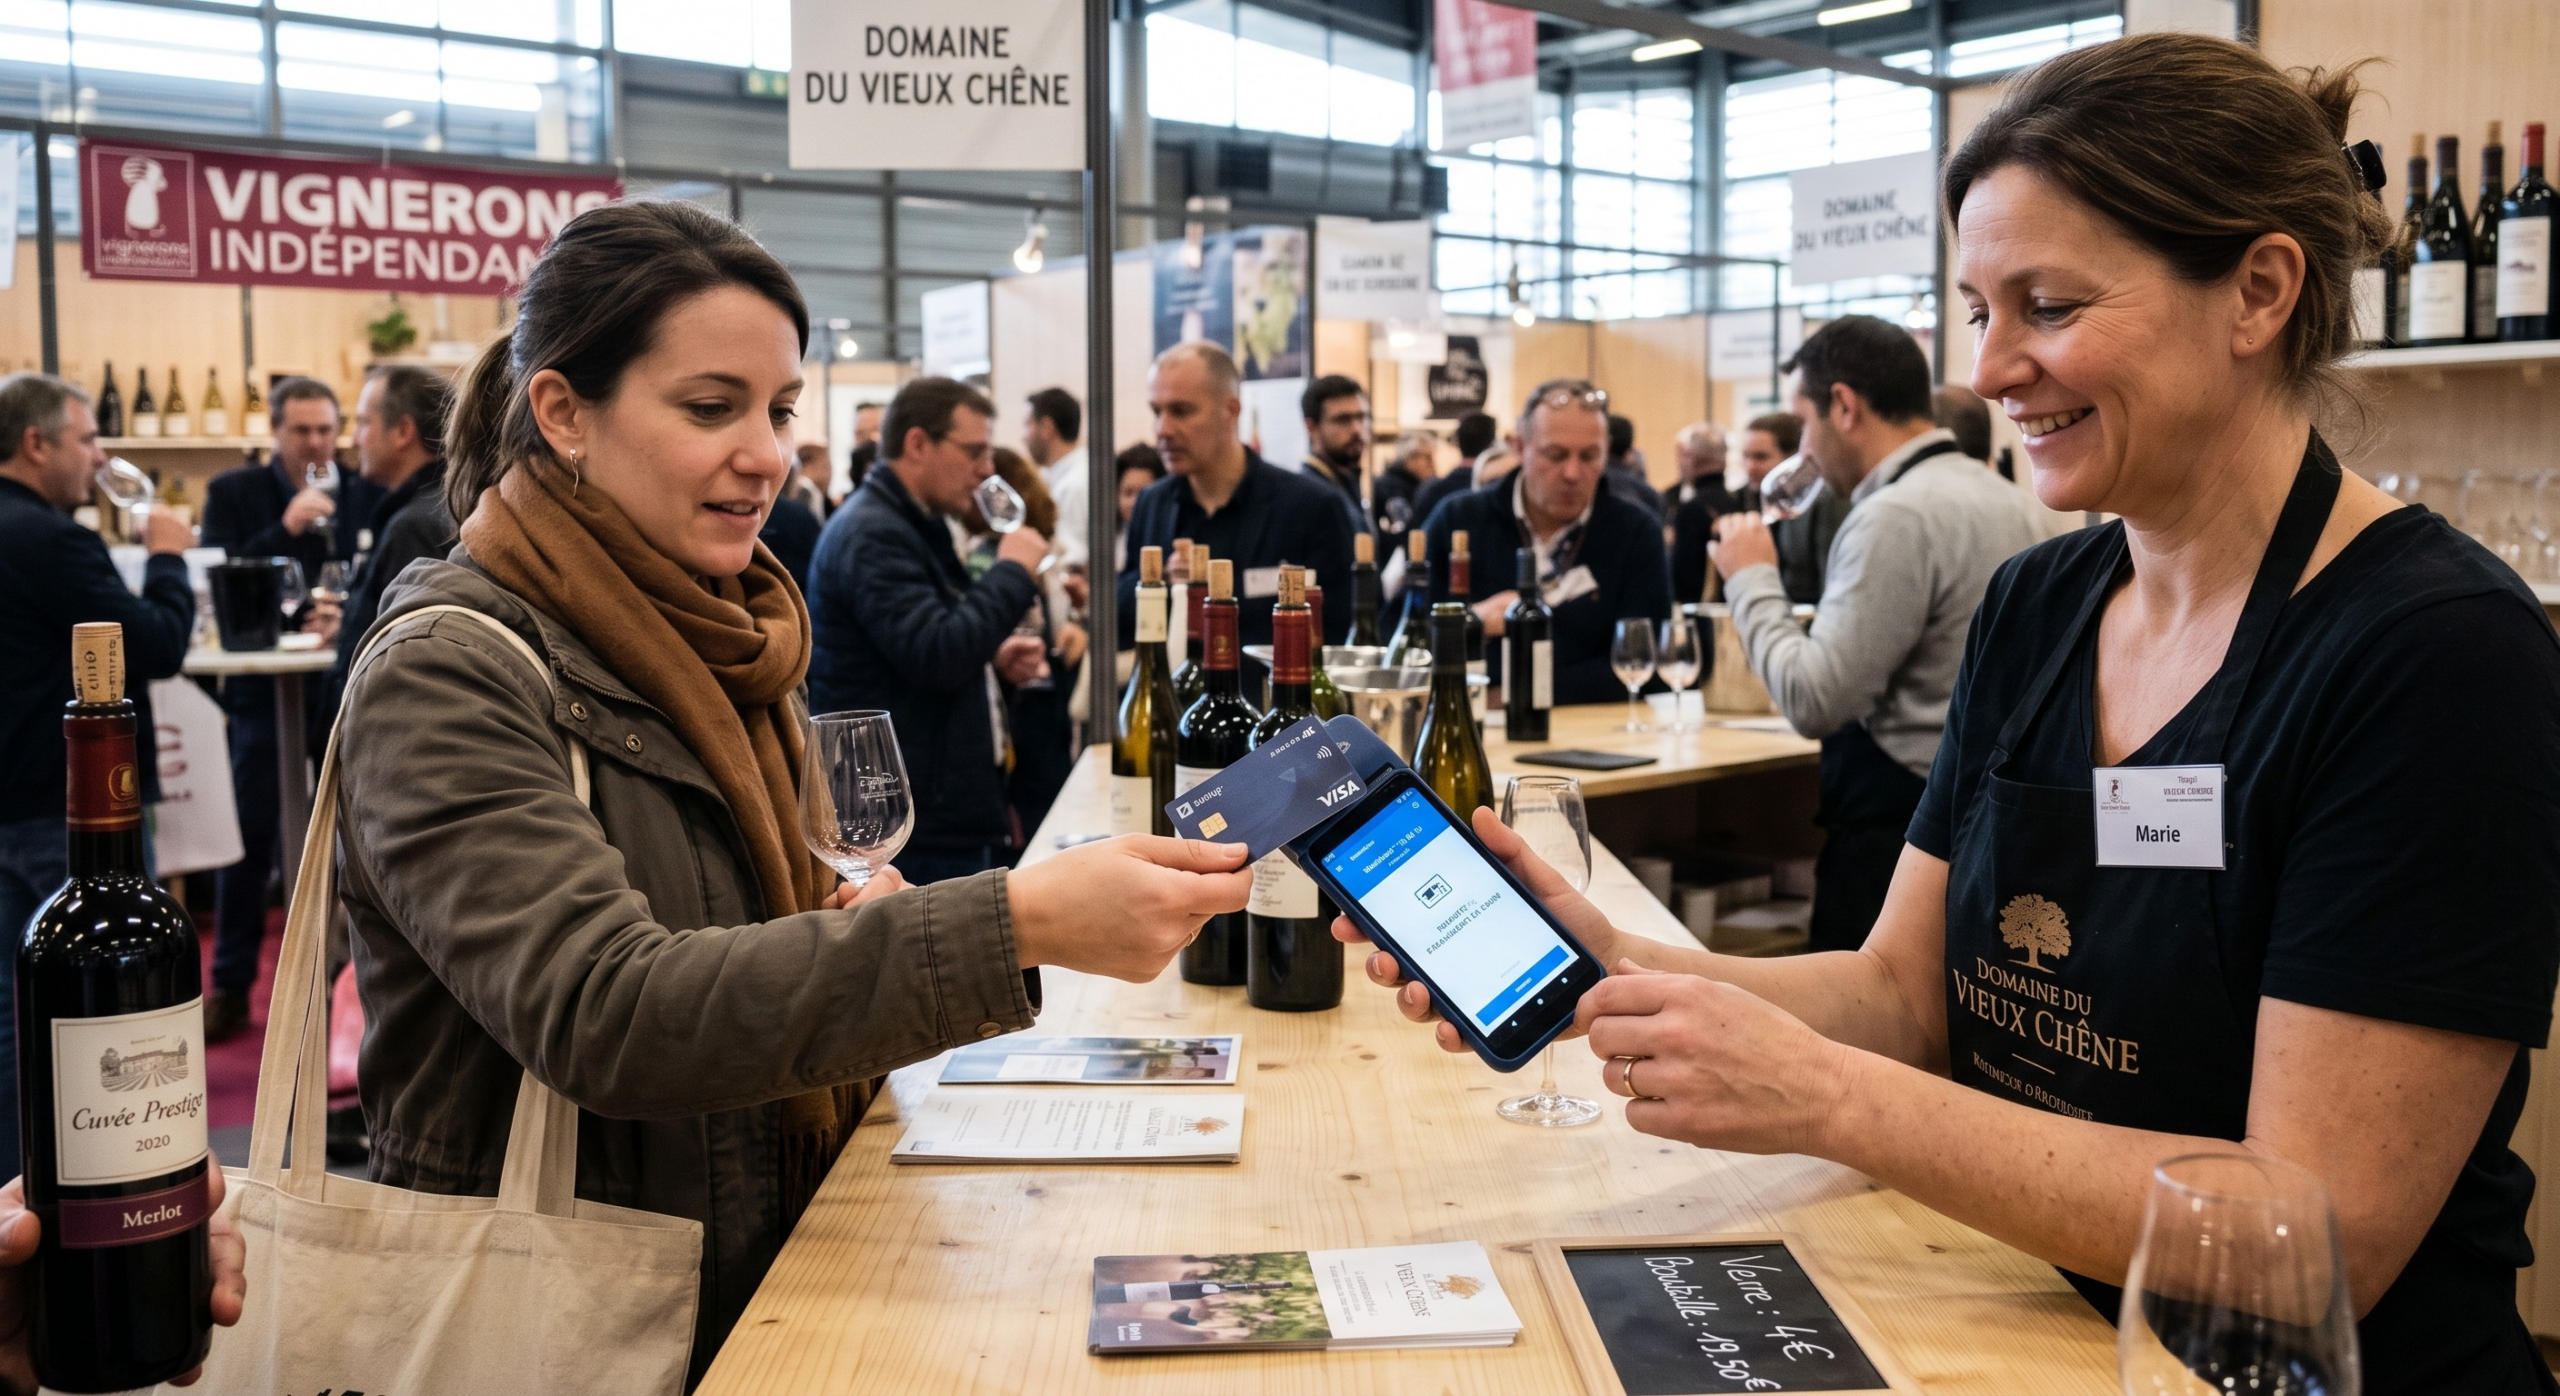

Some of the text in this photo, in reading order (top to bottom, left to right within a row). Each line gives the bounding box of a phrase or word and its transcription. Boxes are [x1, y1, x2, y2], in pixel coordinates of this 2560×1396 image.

[865, 25, 1010, 58] DOMAINE
[806, 64, 1070, 106] DU VIEUX CHÊNE
[1316, 780, 1361, 807] VISA
[2136, 825, 2181, 843] Marie
[1976, 956, 2092, 1016] DOMAINE DU
[1953, 968, 2140, 1075] VIEUX CHÊNE
[72, 1106, 136, 1131] Cuvée
[135, 1133, 171, 1153] 2020
[122, 1203, 183, 1229] Merlot
[1764, 1324, 1836, 1362] 4€
